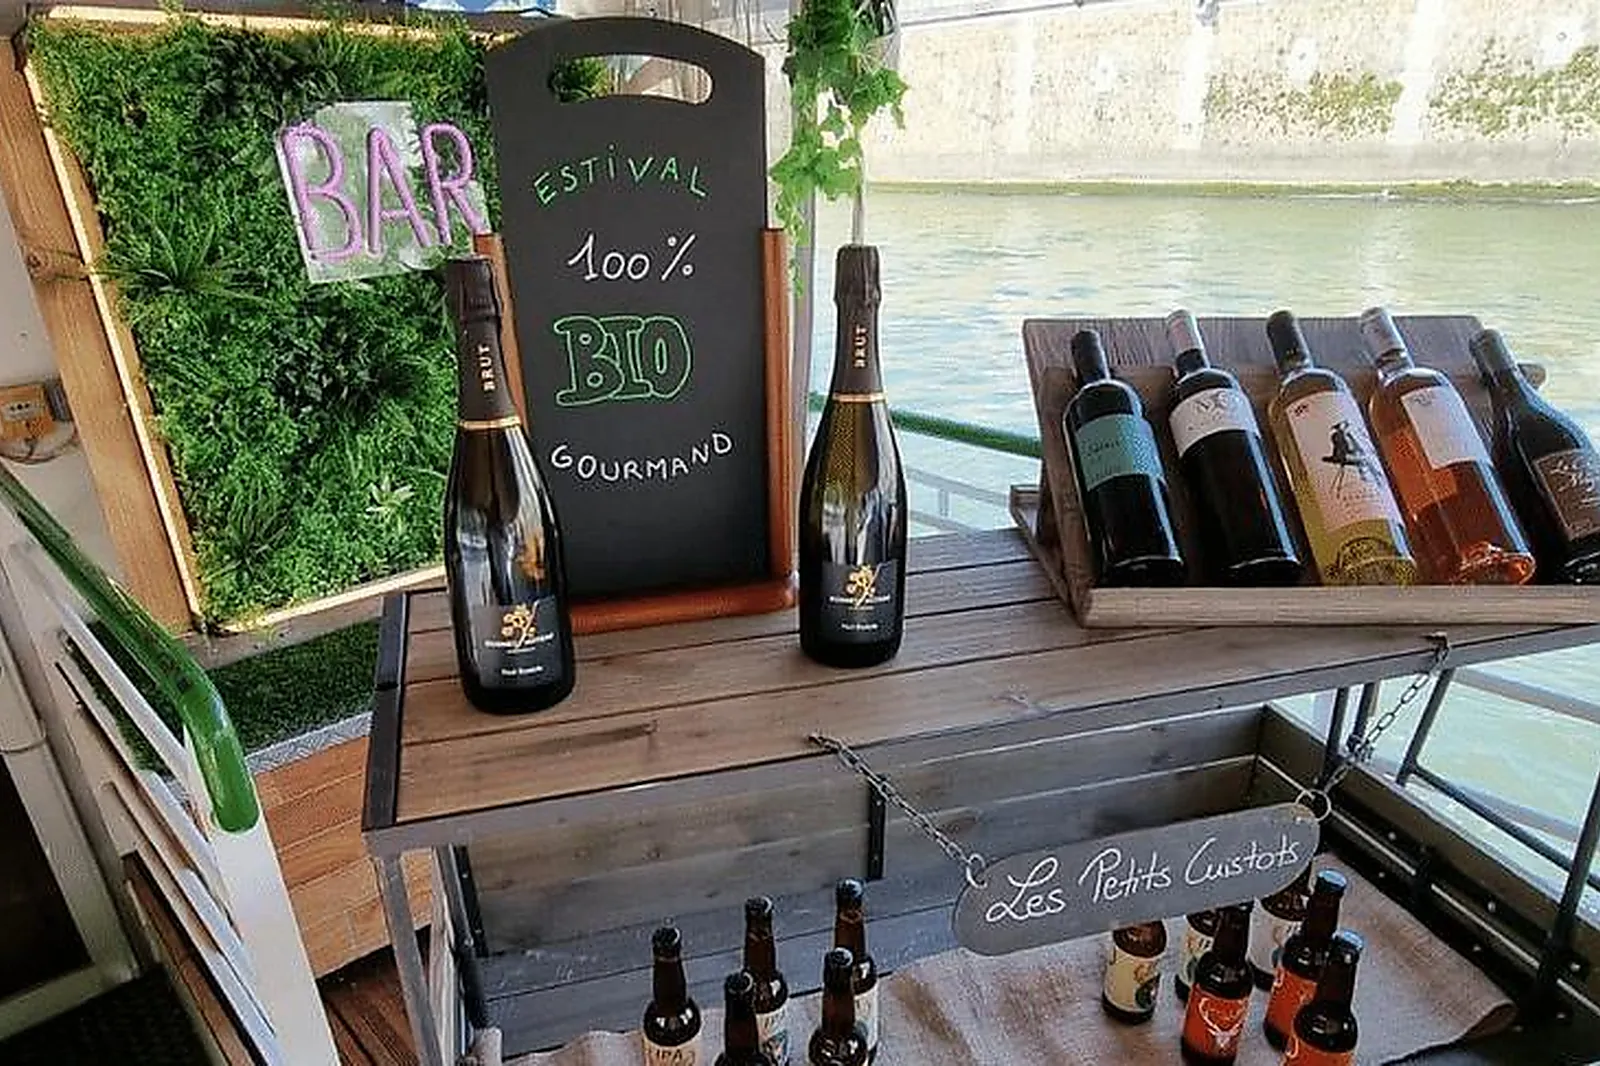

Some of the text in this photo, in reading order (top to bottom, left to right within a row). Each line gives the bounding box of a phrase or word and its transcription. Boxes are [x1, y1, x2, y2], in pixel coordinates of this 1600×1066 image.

[281, 121, 487, 260] BAR
[478, 344, 495, 391] BRUT
[553, 315, 692, 407] BIO
[854, 324, 867, 368] BRUT
[551, 432, 733, 481] GOURMAND
[985, 834, 1300, 922] Les Petits Cuistots
